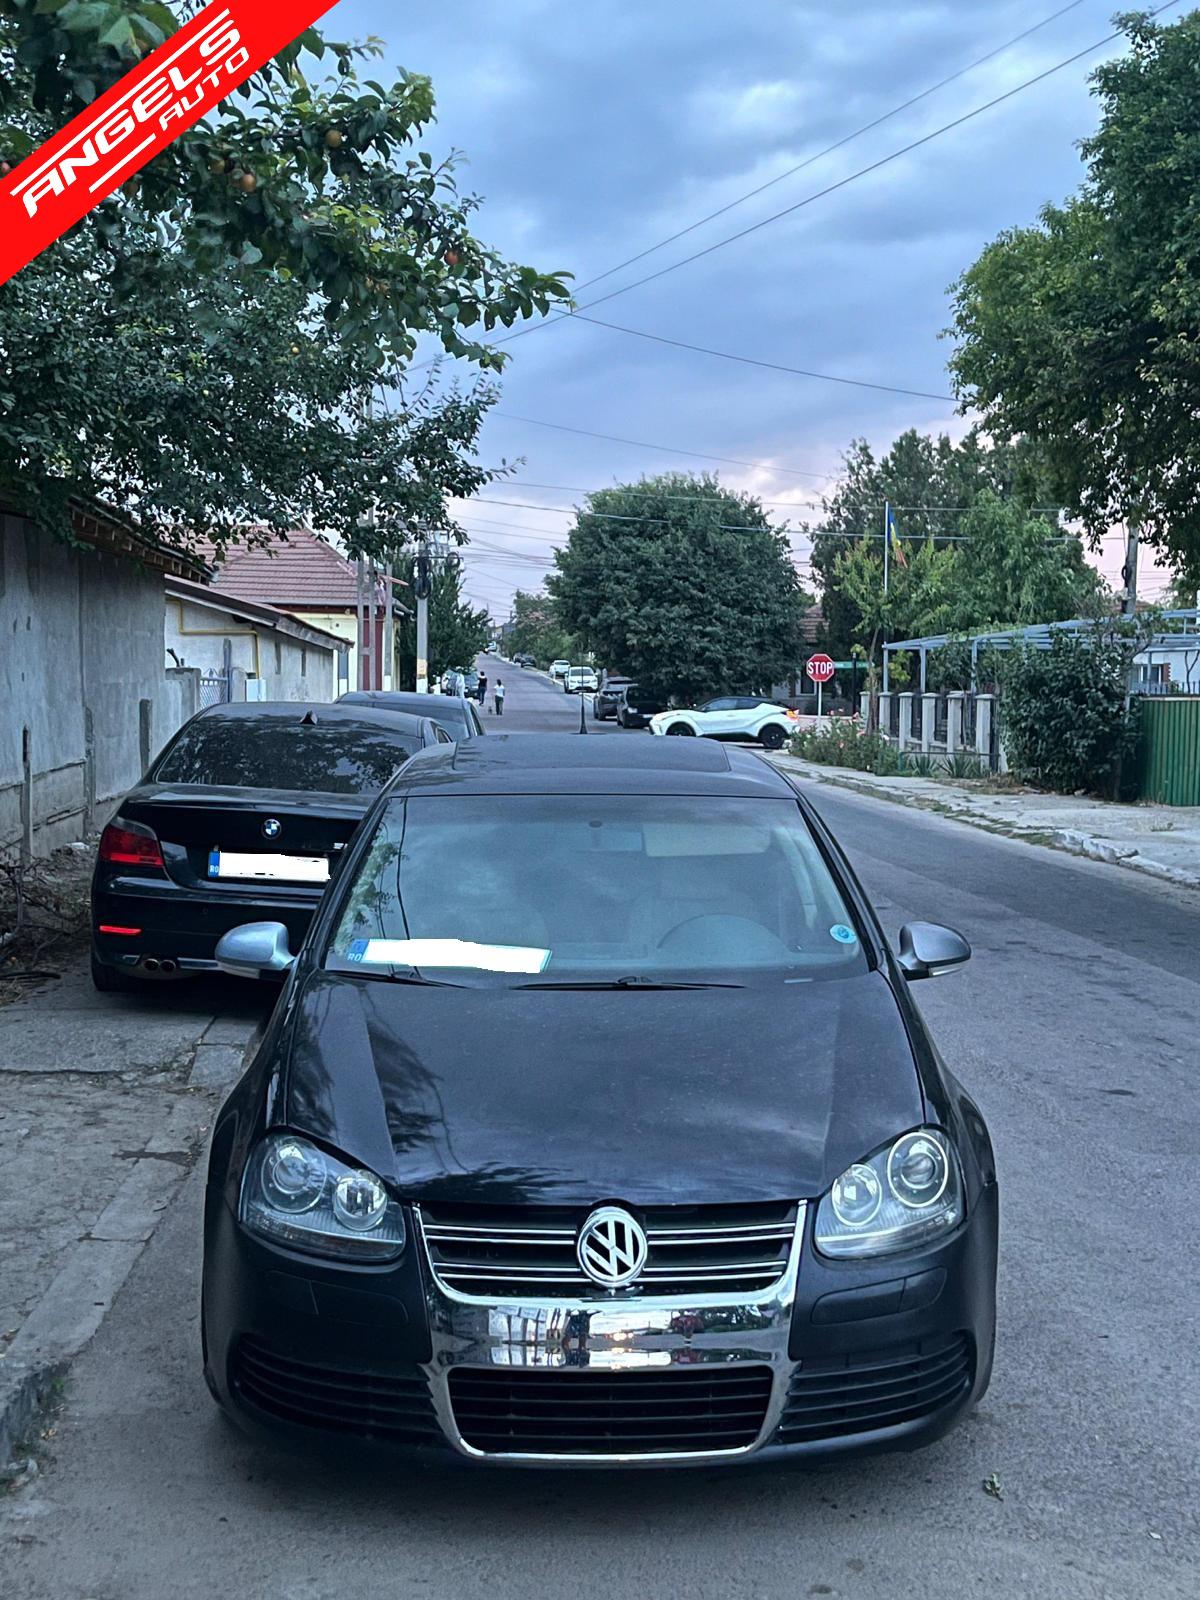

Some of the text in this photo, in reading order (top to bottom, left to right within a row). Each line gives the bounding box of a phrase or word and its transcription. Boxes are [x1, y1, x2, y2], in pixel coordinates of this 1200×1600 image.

[807, 661, 833, 675] STOP
[209, 864, 219, 873] RO
[347, 952, 362, 962] RO
